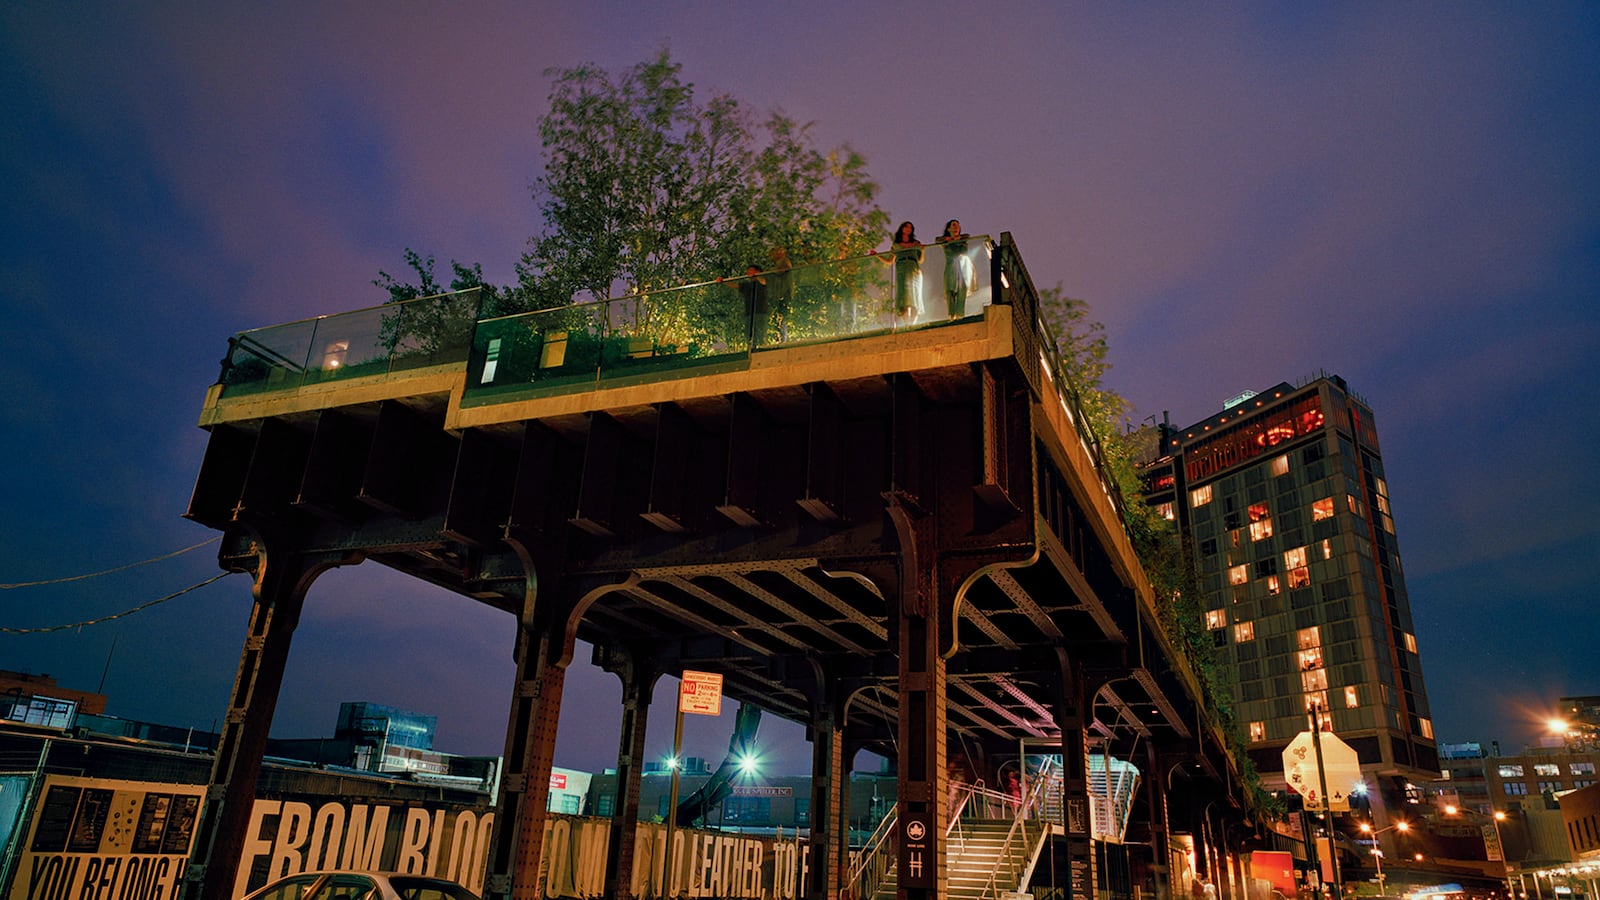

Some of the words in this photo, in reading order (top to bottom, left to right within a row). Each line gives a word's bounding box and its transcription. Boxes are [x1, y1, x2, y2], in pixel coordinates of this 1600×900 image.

[684, 682, 696, 693] NO
[231, 799, 390, 900] FROM
[688, 833, 766, 900] LEATHER,
[773, 842, 796, 899] TO
[27, 855, 80, 900] YOU
